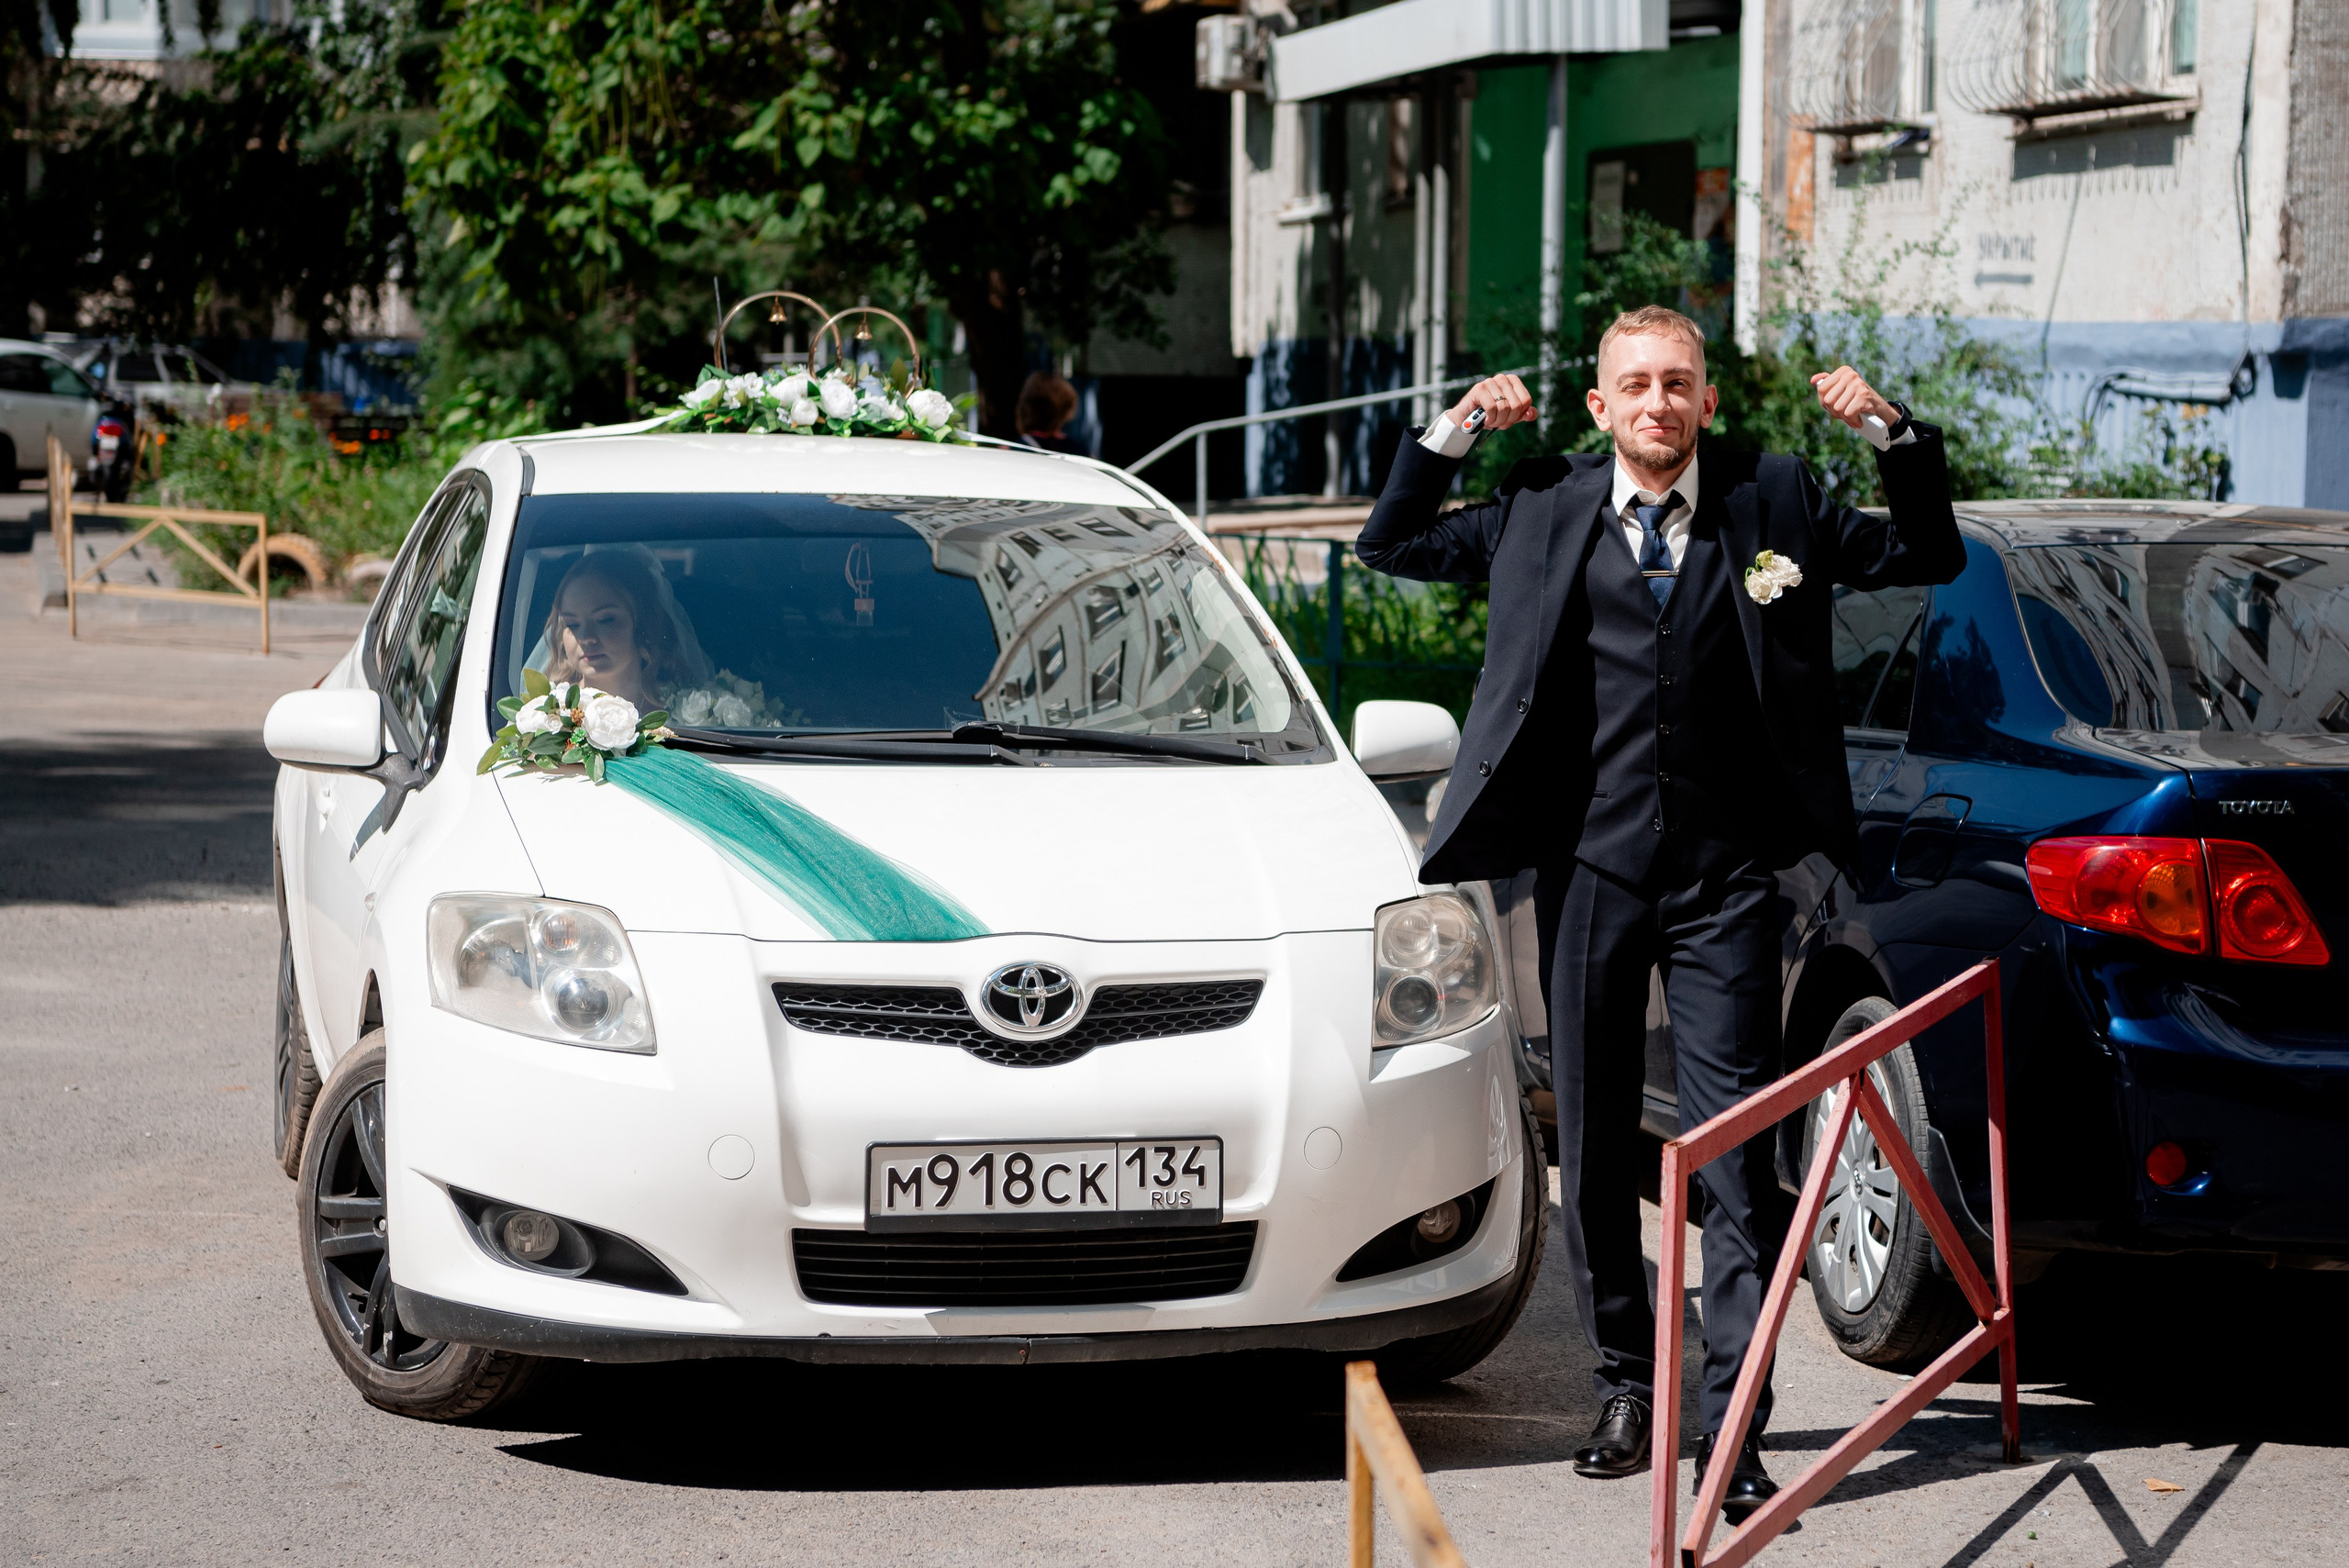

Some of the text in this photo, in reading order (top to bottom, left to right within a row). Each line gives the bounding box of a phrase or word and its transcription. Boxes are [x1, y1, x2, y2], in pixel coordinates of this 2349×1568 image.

[2219, 800, 2295, 814] TOYOTA
[1125, 1146, 1207, 1188] 134
[1151, 1190, 1191, 1206] RUS
